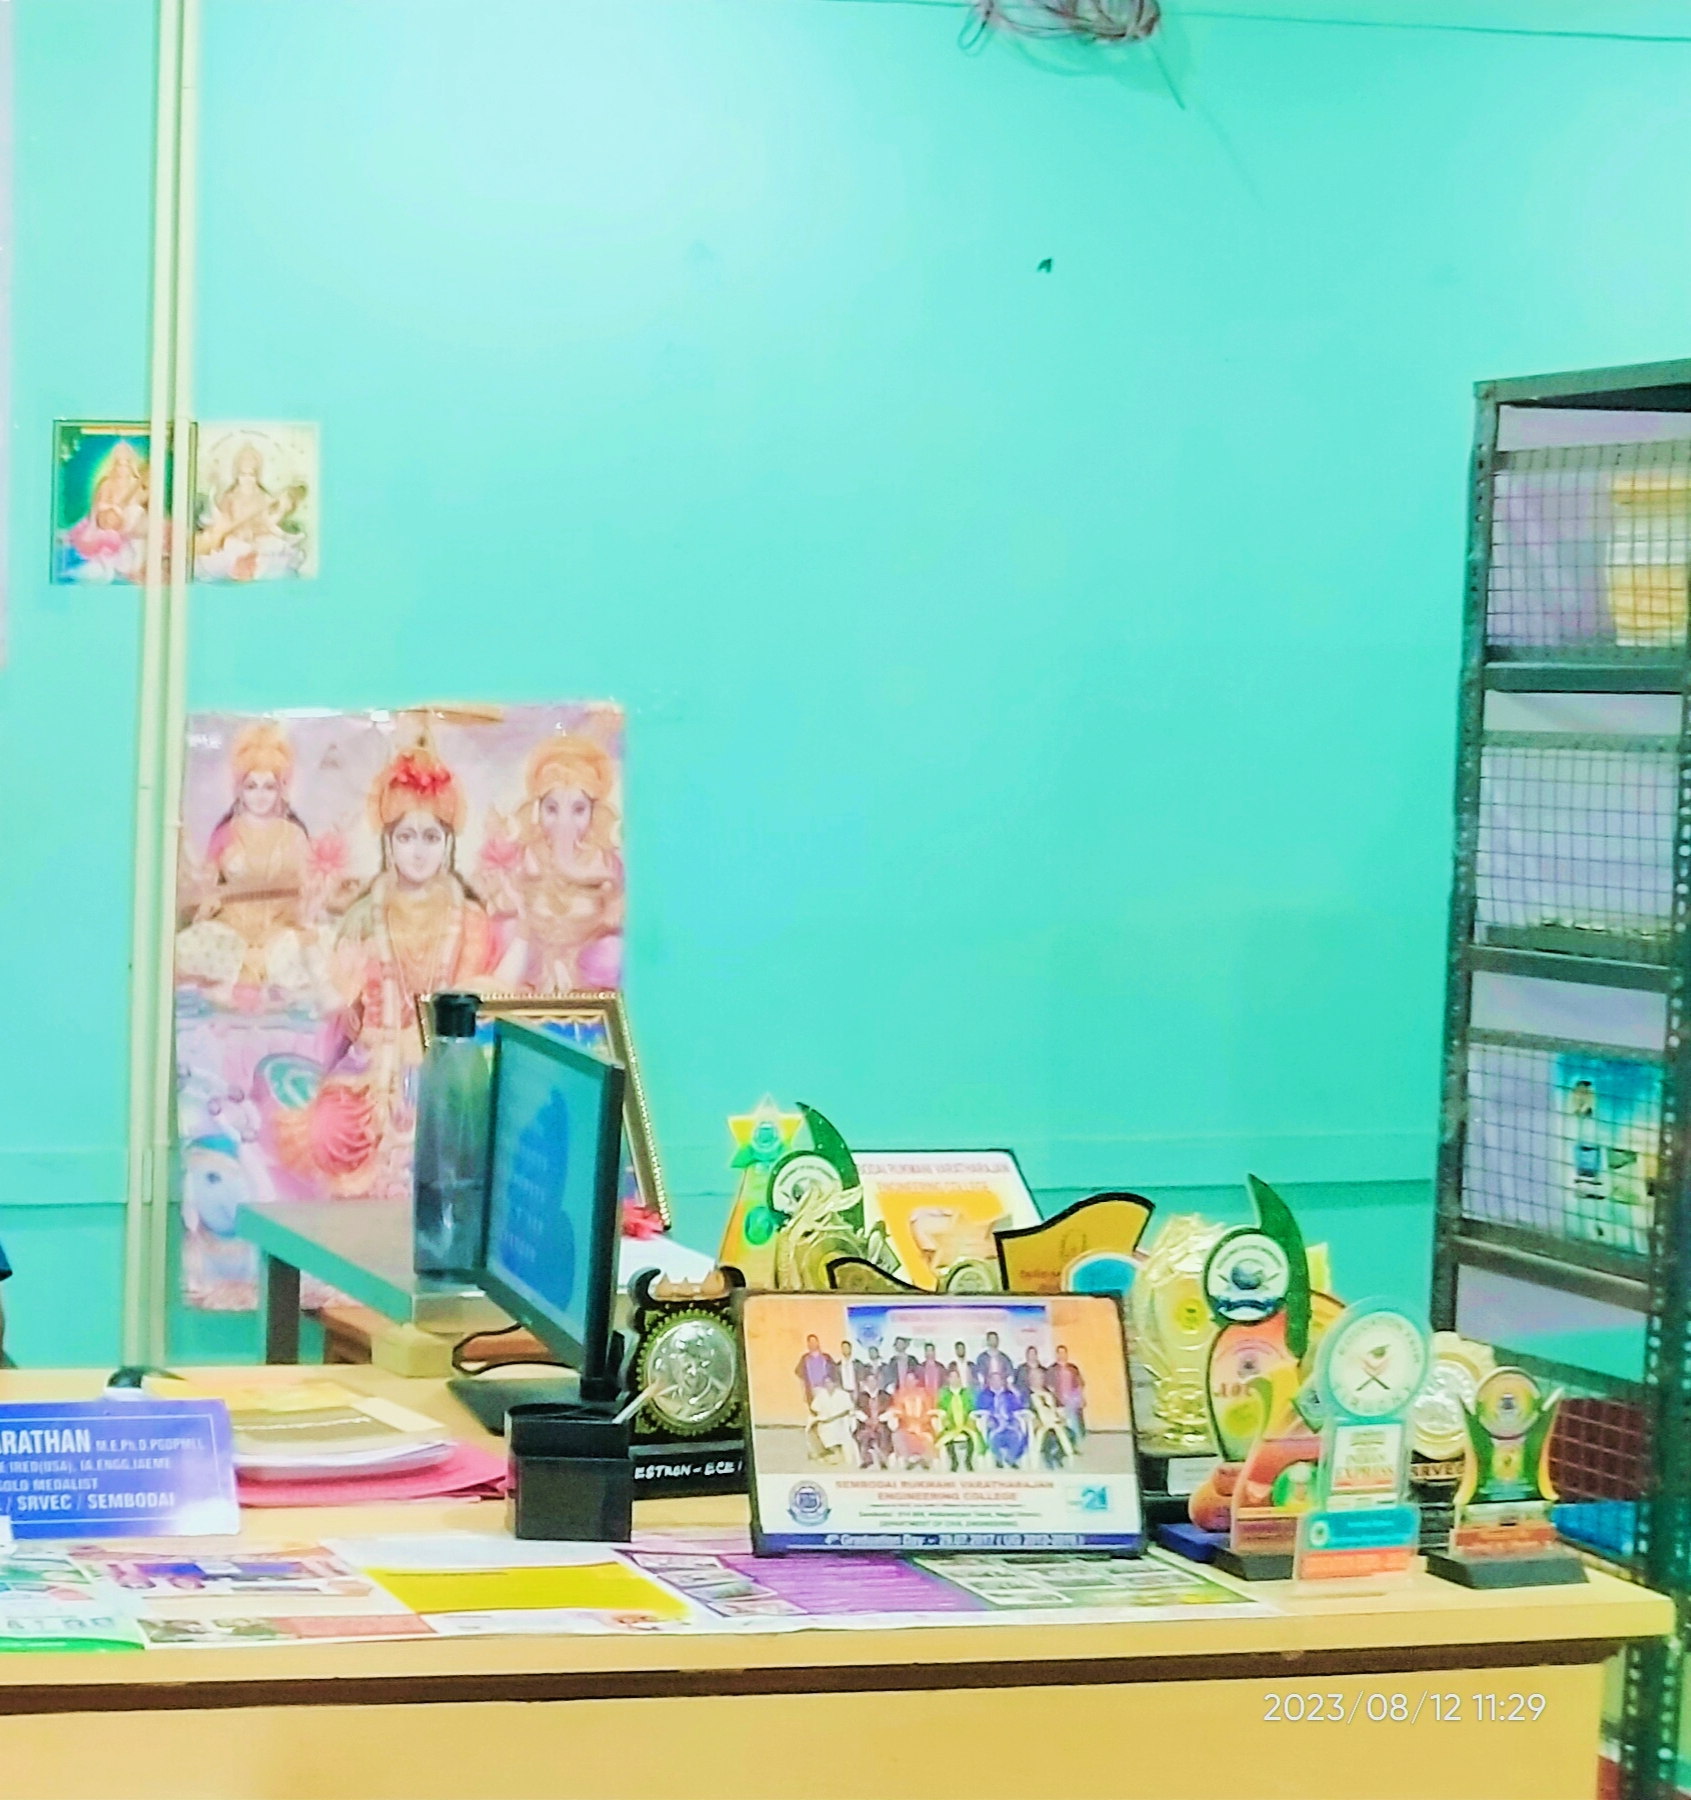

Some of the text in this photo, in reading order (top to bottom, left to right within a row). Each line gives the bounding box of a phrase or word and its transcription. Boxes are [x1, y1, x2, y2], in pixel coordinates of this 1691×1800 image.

[33, 1477, 99, 1492] MEDALIST
[835, 1480, 897, 1490] SEMBODAI
[17, 1494, 72, 1511] SRVEC
[86, 1491, 176, 1510] SEMBODAI
